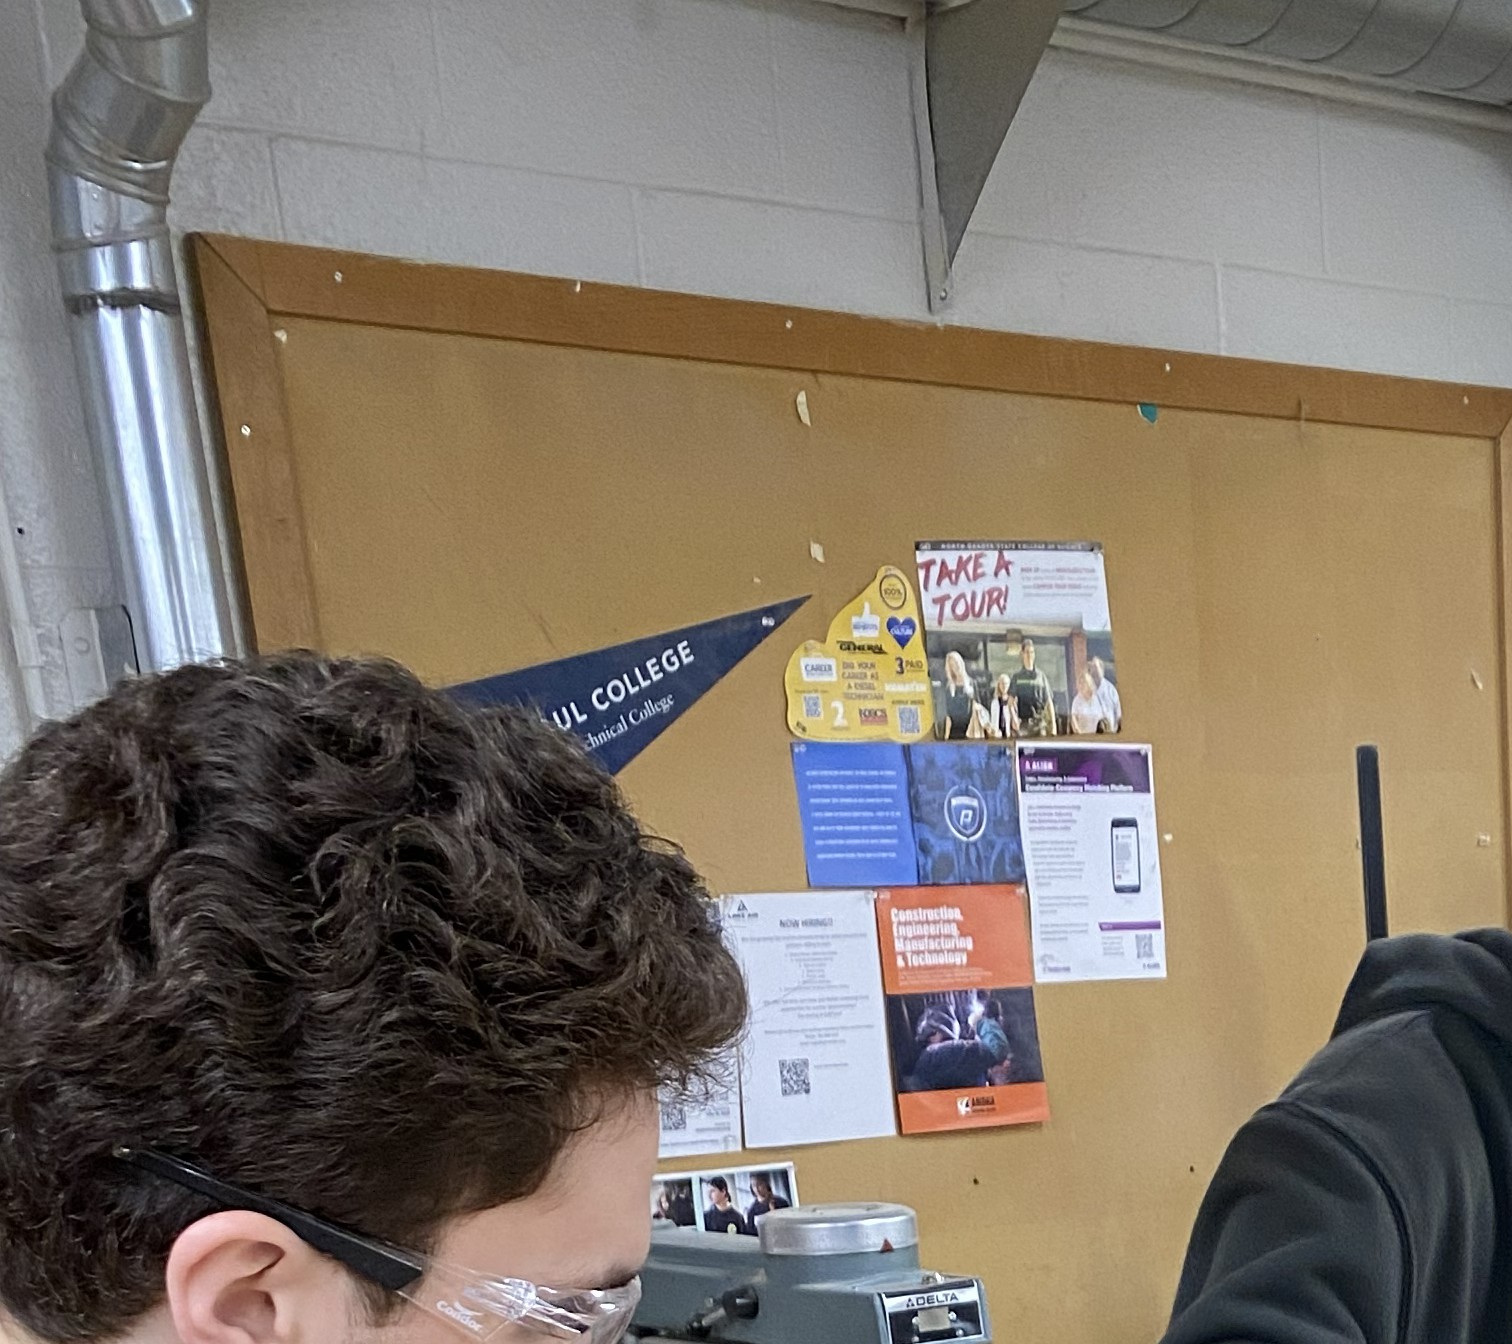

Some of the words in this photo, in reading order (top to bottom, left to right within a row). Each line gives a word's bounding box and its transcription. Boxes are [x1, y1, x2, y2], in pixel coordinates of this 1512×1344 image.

[918, 551, 988, 593] TAKE
[993, 548, 1014, 579] A
[932, 583, 1010, 628] TOUR!
[895, 656, 905, 675] 3
[591, 640, 695, 712] COLLEGE
[628, 693, 675, 726] College
[891, 904, 964, 923] Construction,
[894, 936, 974, 952] Manufacturing
[897, 953, 906, 968] &
[907, 949, 968, 968] Technology
[916, 1292, 959, 1306] DELTA
